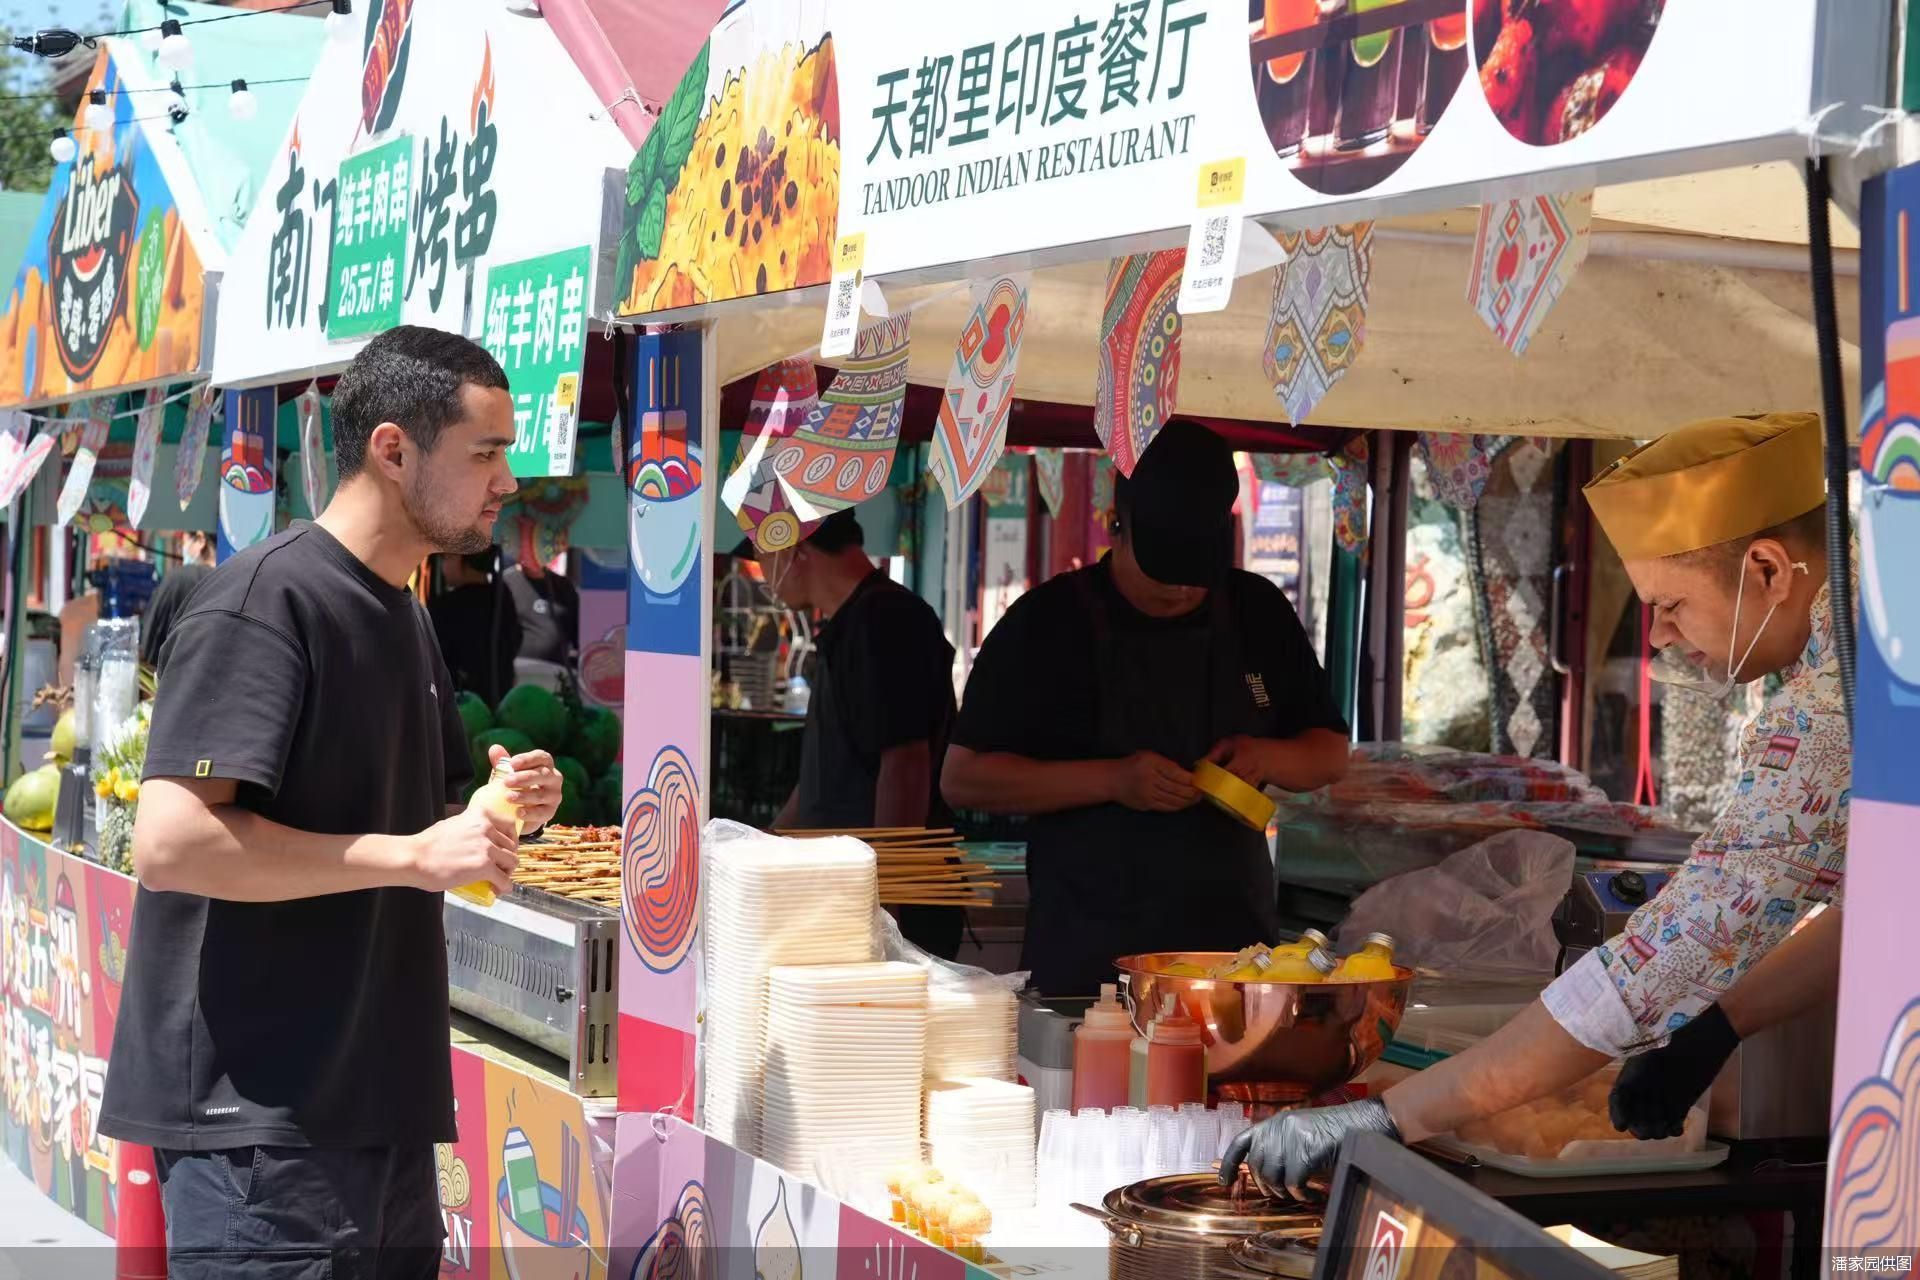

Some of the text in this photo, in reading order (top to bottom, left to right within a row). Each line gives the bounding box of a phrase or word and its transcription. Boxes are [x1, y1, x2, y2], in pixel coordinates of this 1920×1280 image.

[866, 0, 1207, 166] 天都里印度餐厅
[62, 160, 120, 254] Liber
[336, 152, 408, 246] 纯羊肉串
[862, 114, 1196, 216] TANDOOR INDIAN RESTAURANT
[337, 253, 395, 318] 25元/串
[485, 266, 584, 370] 纯羊肉串
